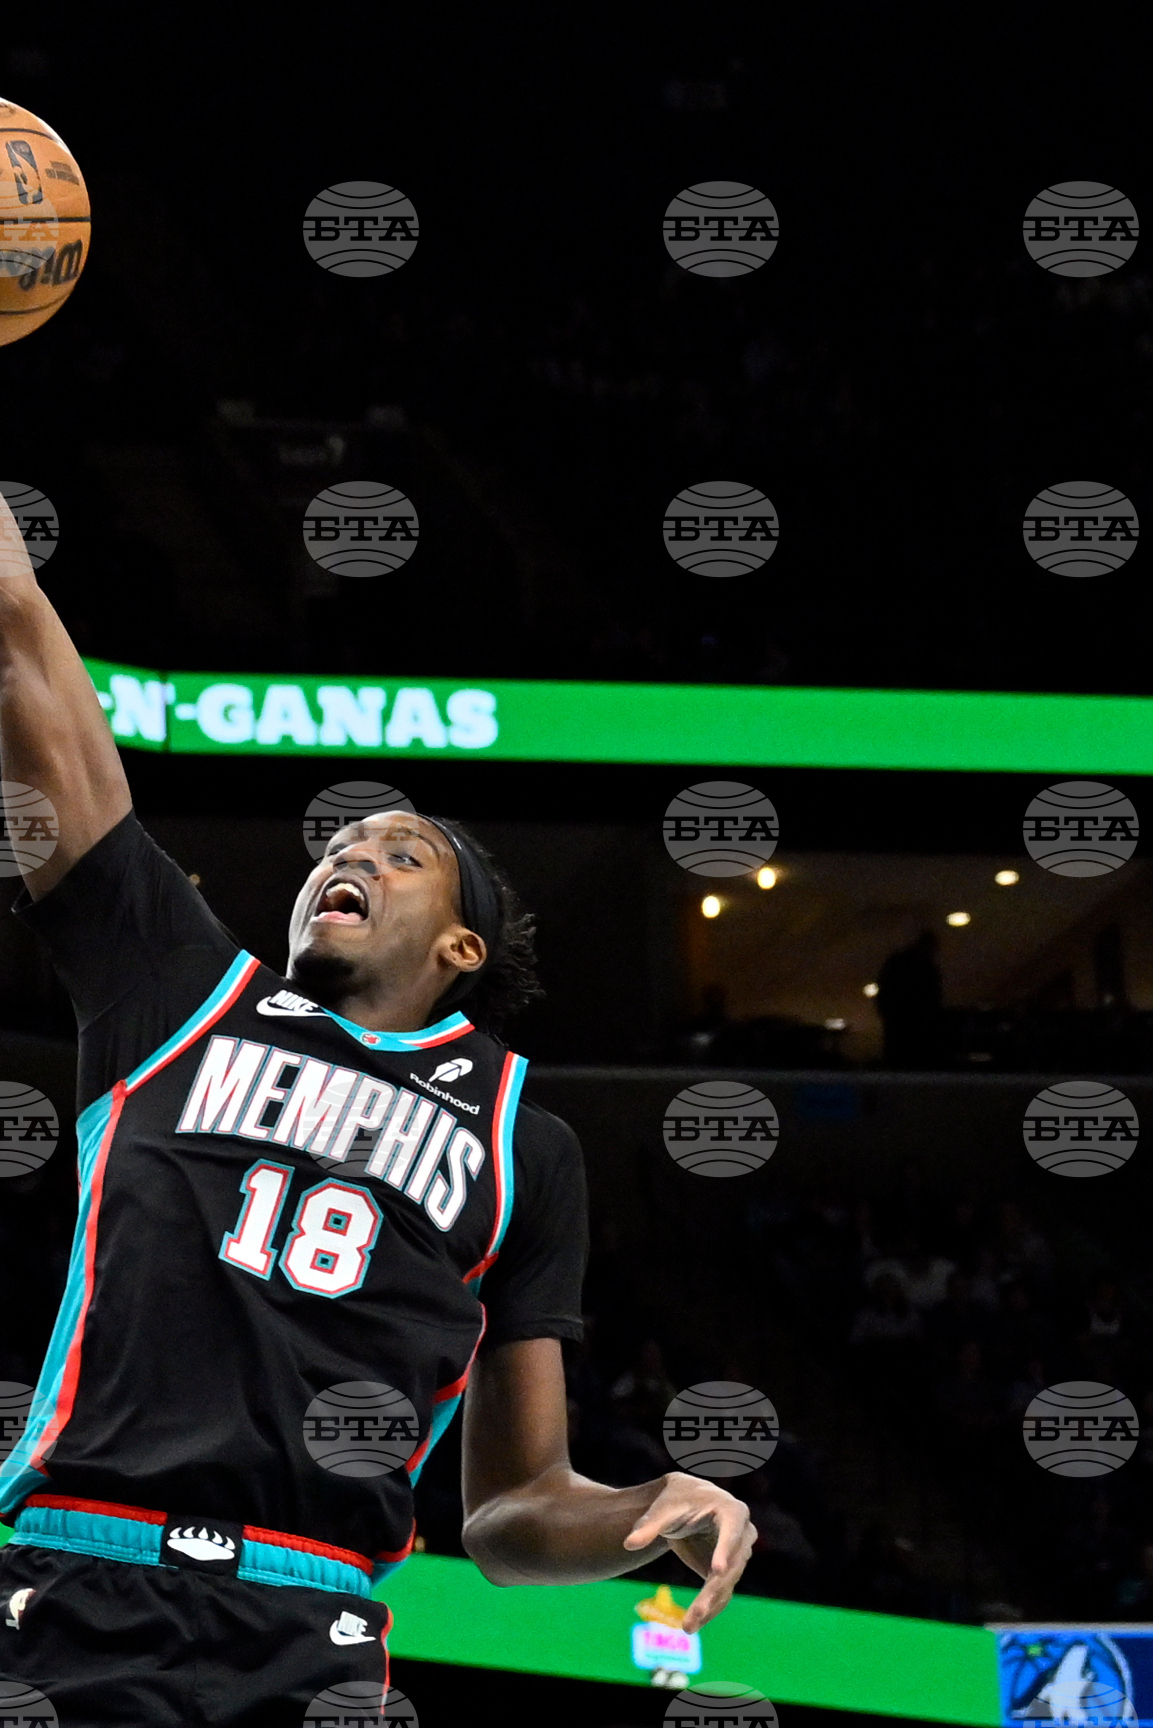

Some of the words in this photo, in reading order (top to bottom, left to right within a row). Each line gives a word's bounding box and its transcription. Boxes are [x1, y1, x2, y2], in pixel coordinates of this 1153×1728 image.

[268, 989, 319, 1014] NIKE
[175, 1034, 486, 1232] MEMPHIS
[409, 1072, 481, 1116] Robinhood
[218, 1158, 384, 1299] 18
